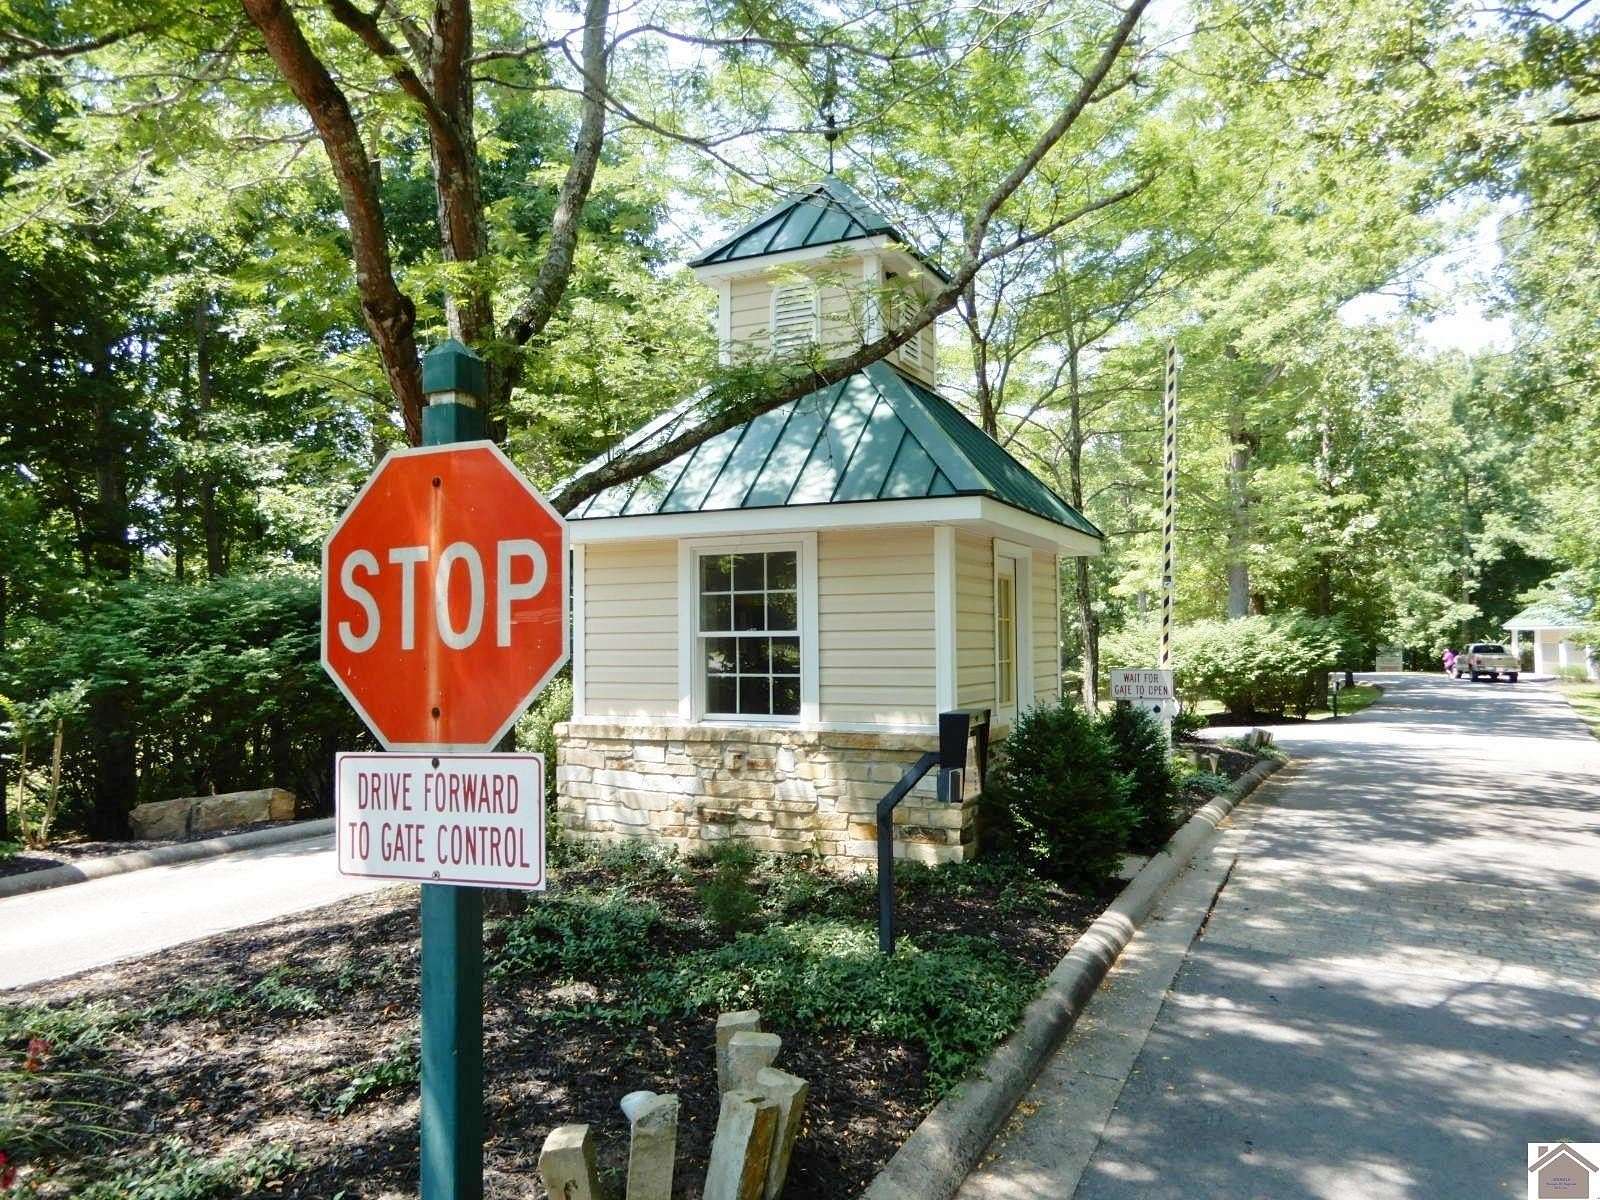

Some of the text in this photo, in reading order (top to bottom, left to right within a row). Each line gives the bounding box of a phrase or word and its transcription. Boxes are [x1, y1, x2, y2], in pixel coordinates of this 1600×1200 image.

[338, 539, 548, 653] STOP
[1114, 685, 1168, 695] GATE TO OPEN
[1123, 673, 1159, 683] WAIT FOR
[358, 772, 519, 814] DRIVE FORWARD
[349, 821, 530, 868] TO GATE CONTROL
